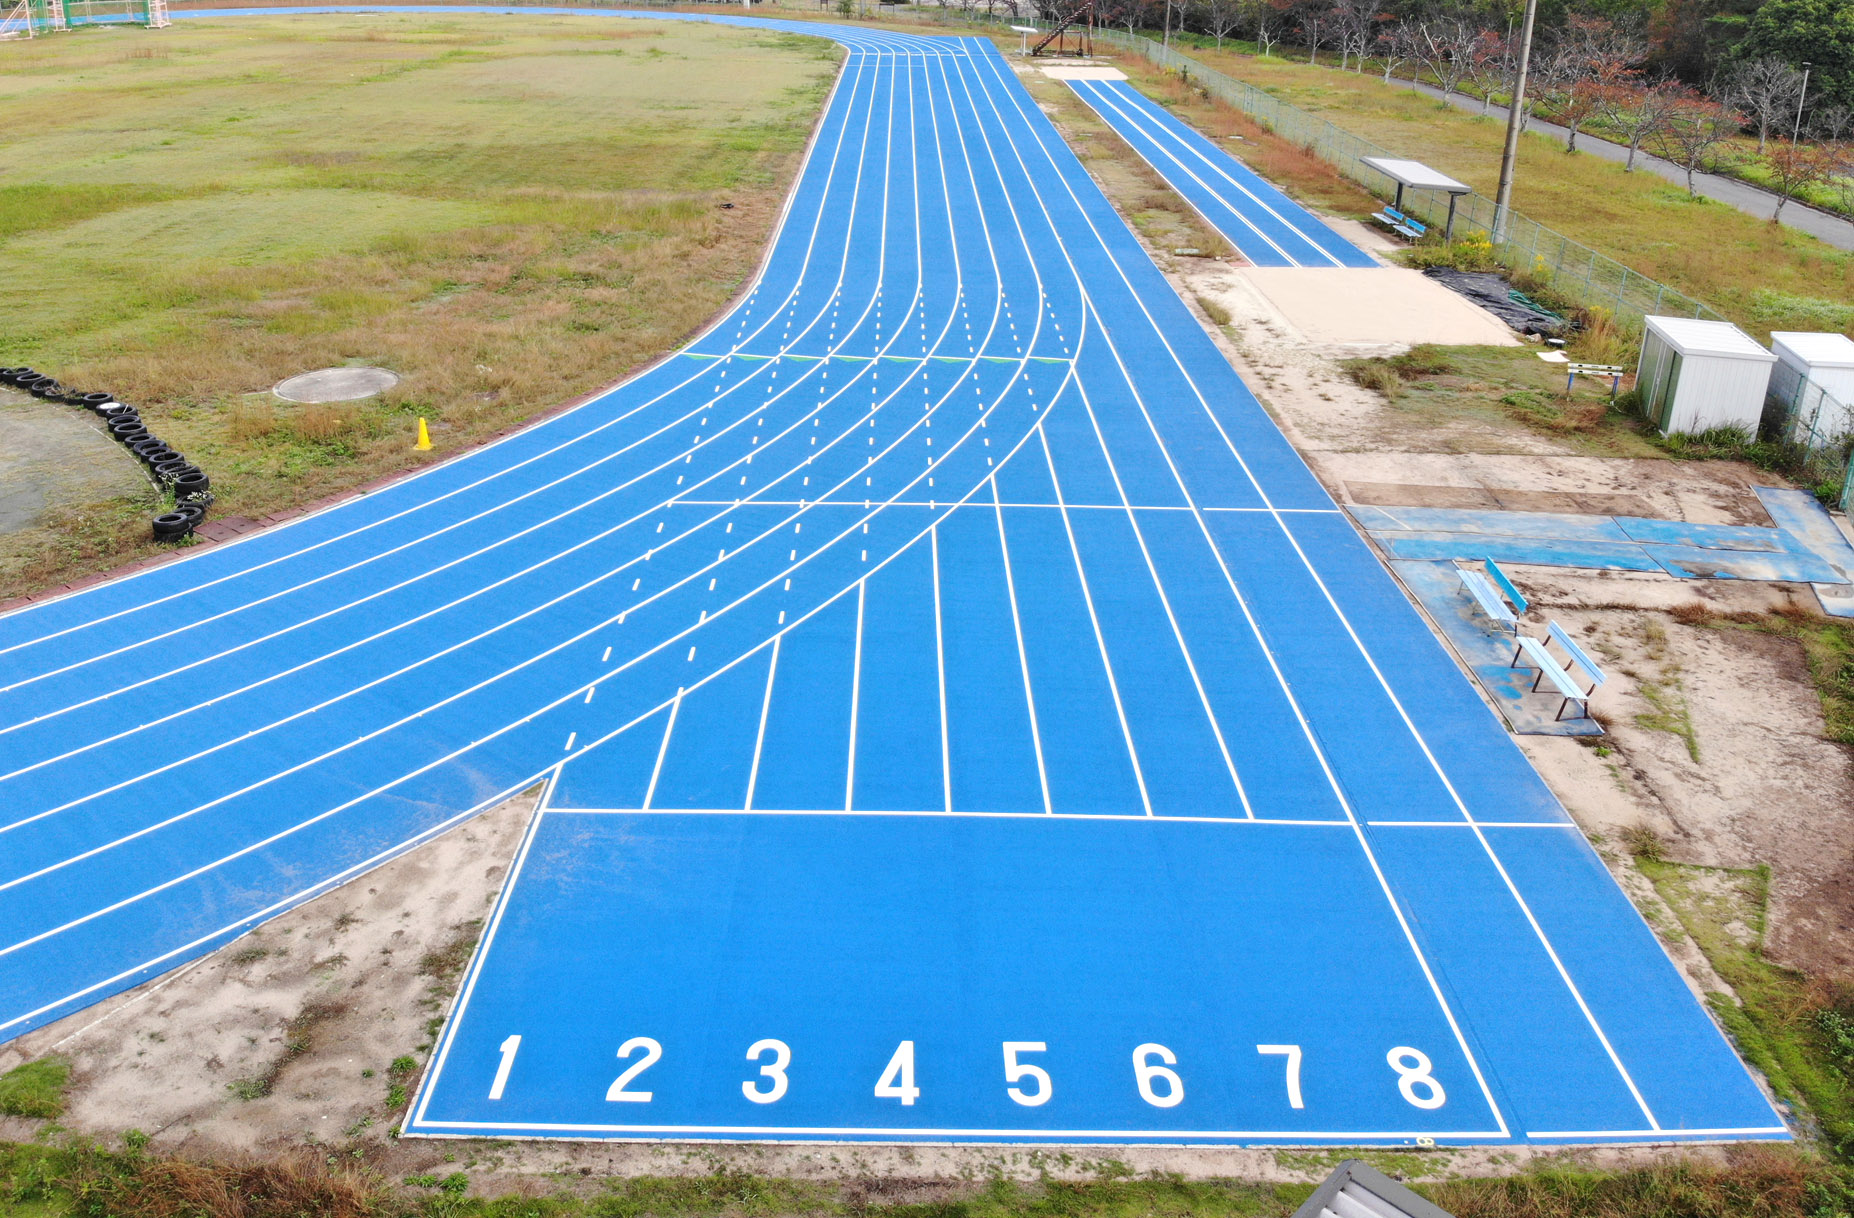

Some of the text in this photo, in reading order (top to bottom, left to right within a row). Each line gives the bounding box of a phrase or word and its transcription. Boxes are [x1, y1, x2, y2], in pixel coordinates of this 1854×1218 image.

[489, 1035, 1446, 1110] 1 2 3 4 5 6 7 8
